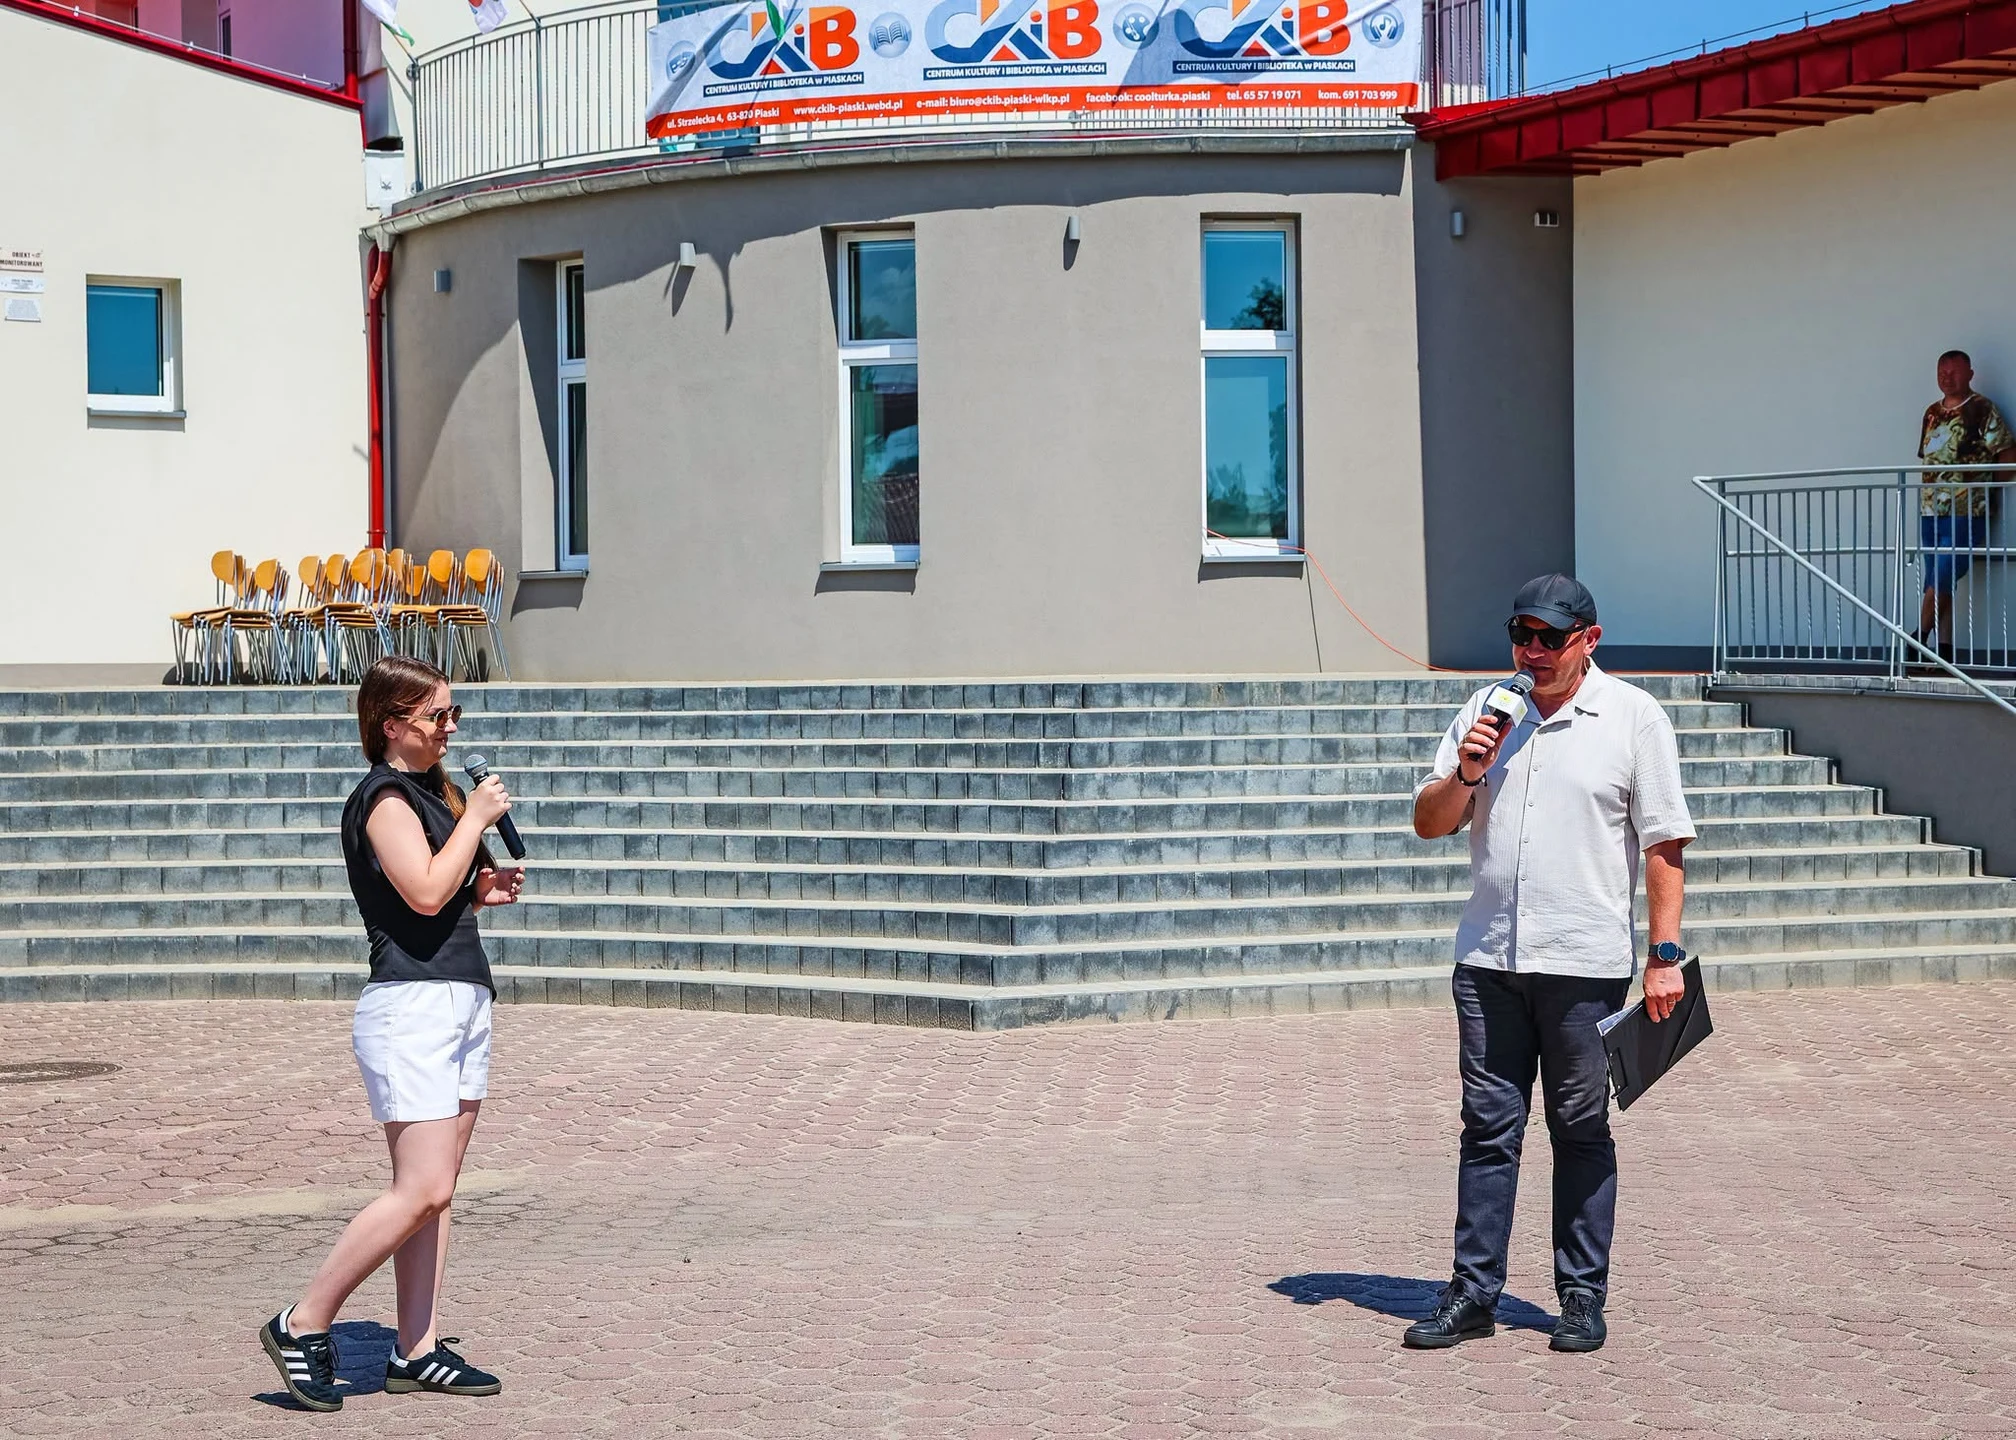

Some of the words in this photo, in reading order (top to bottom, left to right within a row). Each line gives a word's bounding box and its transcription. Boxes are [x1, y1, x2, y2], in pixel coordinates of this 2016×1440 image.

[927, 69, 965, 78] CENTRUM
[965, 67, 1000, 76] KULTURY
[1002, 66, 1005, 74] I
[1005, 65, 1053, 75] BIBLIOTEKA
[1063, 64, 1104, 73] PIASKACH
[1253, 62, 1256, 70] I
[1258, 62, 1302, 70] BIBLIOTEKA
[1314, 62, 1354, 70] PIASKACH
[705, 84, 738, 94] CENTRUM
[738, 82, 769, 91] KULTURY
[773, 77, 813, 87] BIBLIOTEKA
[824, 74, 862, 84] PIASKACH
[916, 98, 948, 108] e-mail:
[950, 93, 1069, 106] biuro@ckib.piaski-wlkp.pl
[1086, 93, 1133, 102] facebook:
[1134, 91, 1210, 102] coolturka.piaski
[1227, 91, 1242, 100] tel.
[1243, 91, 1256, 100] 65
[1257, 91, 1269, 99] 57
[1271, 90, 1284, 99] 19
[1284, 90, 1301, 99] 071
[1318, 90, 1341, 99] kom.
[1343, 90, 1359, 99] 691
[1362, 90, 1379, 99] 703
[1380, 90, 1397, 99] 999
[793, 100, 902, 115] www.ckib-piaski.webd.pl
[667, 120, 676, 128] ul.
[677, 115, 716, 127] Strzelecka
[716, 114, 724, 122] 4,
[727, 110, 753, 121] 63-820
[755, 108, 779, 118] Piaski
